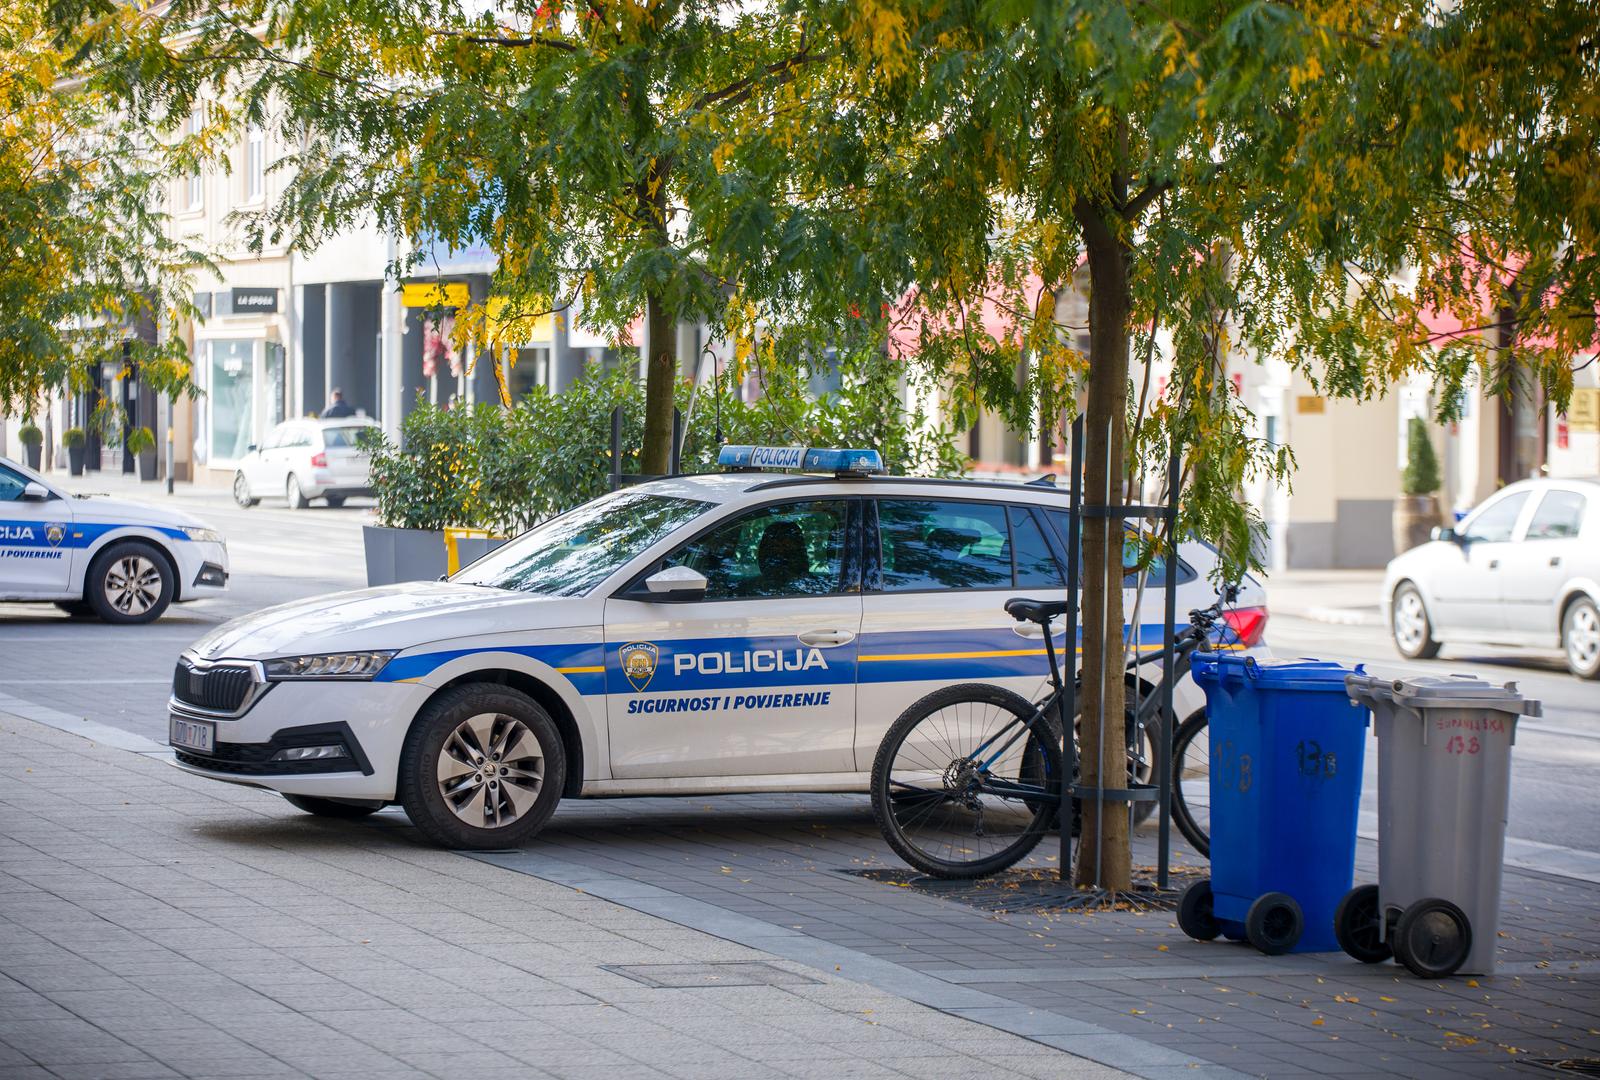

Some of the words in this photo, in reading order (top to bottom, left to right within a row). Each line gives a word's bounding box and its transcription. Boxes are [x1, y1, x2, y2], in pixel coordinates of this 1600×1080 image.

[237, 295, 247, 305] LA
[753, 448, 800, 466] POLICIJA
[7, 550, 62, 559] POVJERENJE
[622, 644, 656, 655] POLICIJA
[674, 649, 829, 676] POLICIJA
[627, 696, 721, 714] SIGURNOST
[723, 695, 731, 710] I
[733, 692, 831, 710] POVJERENJE
